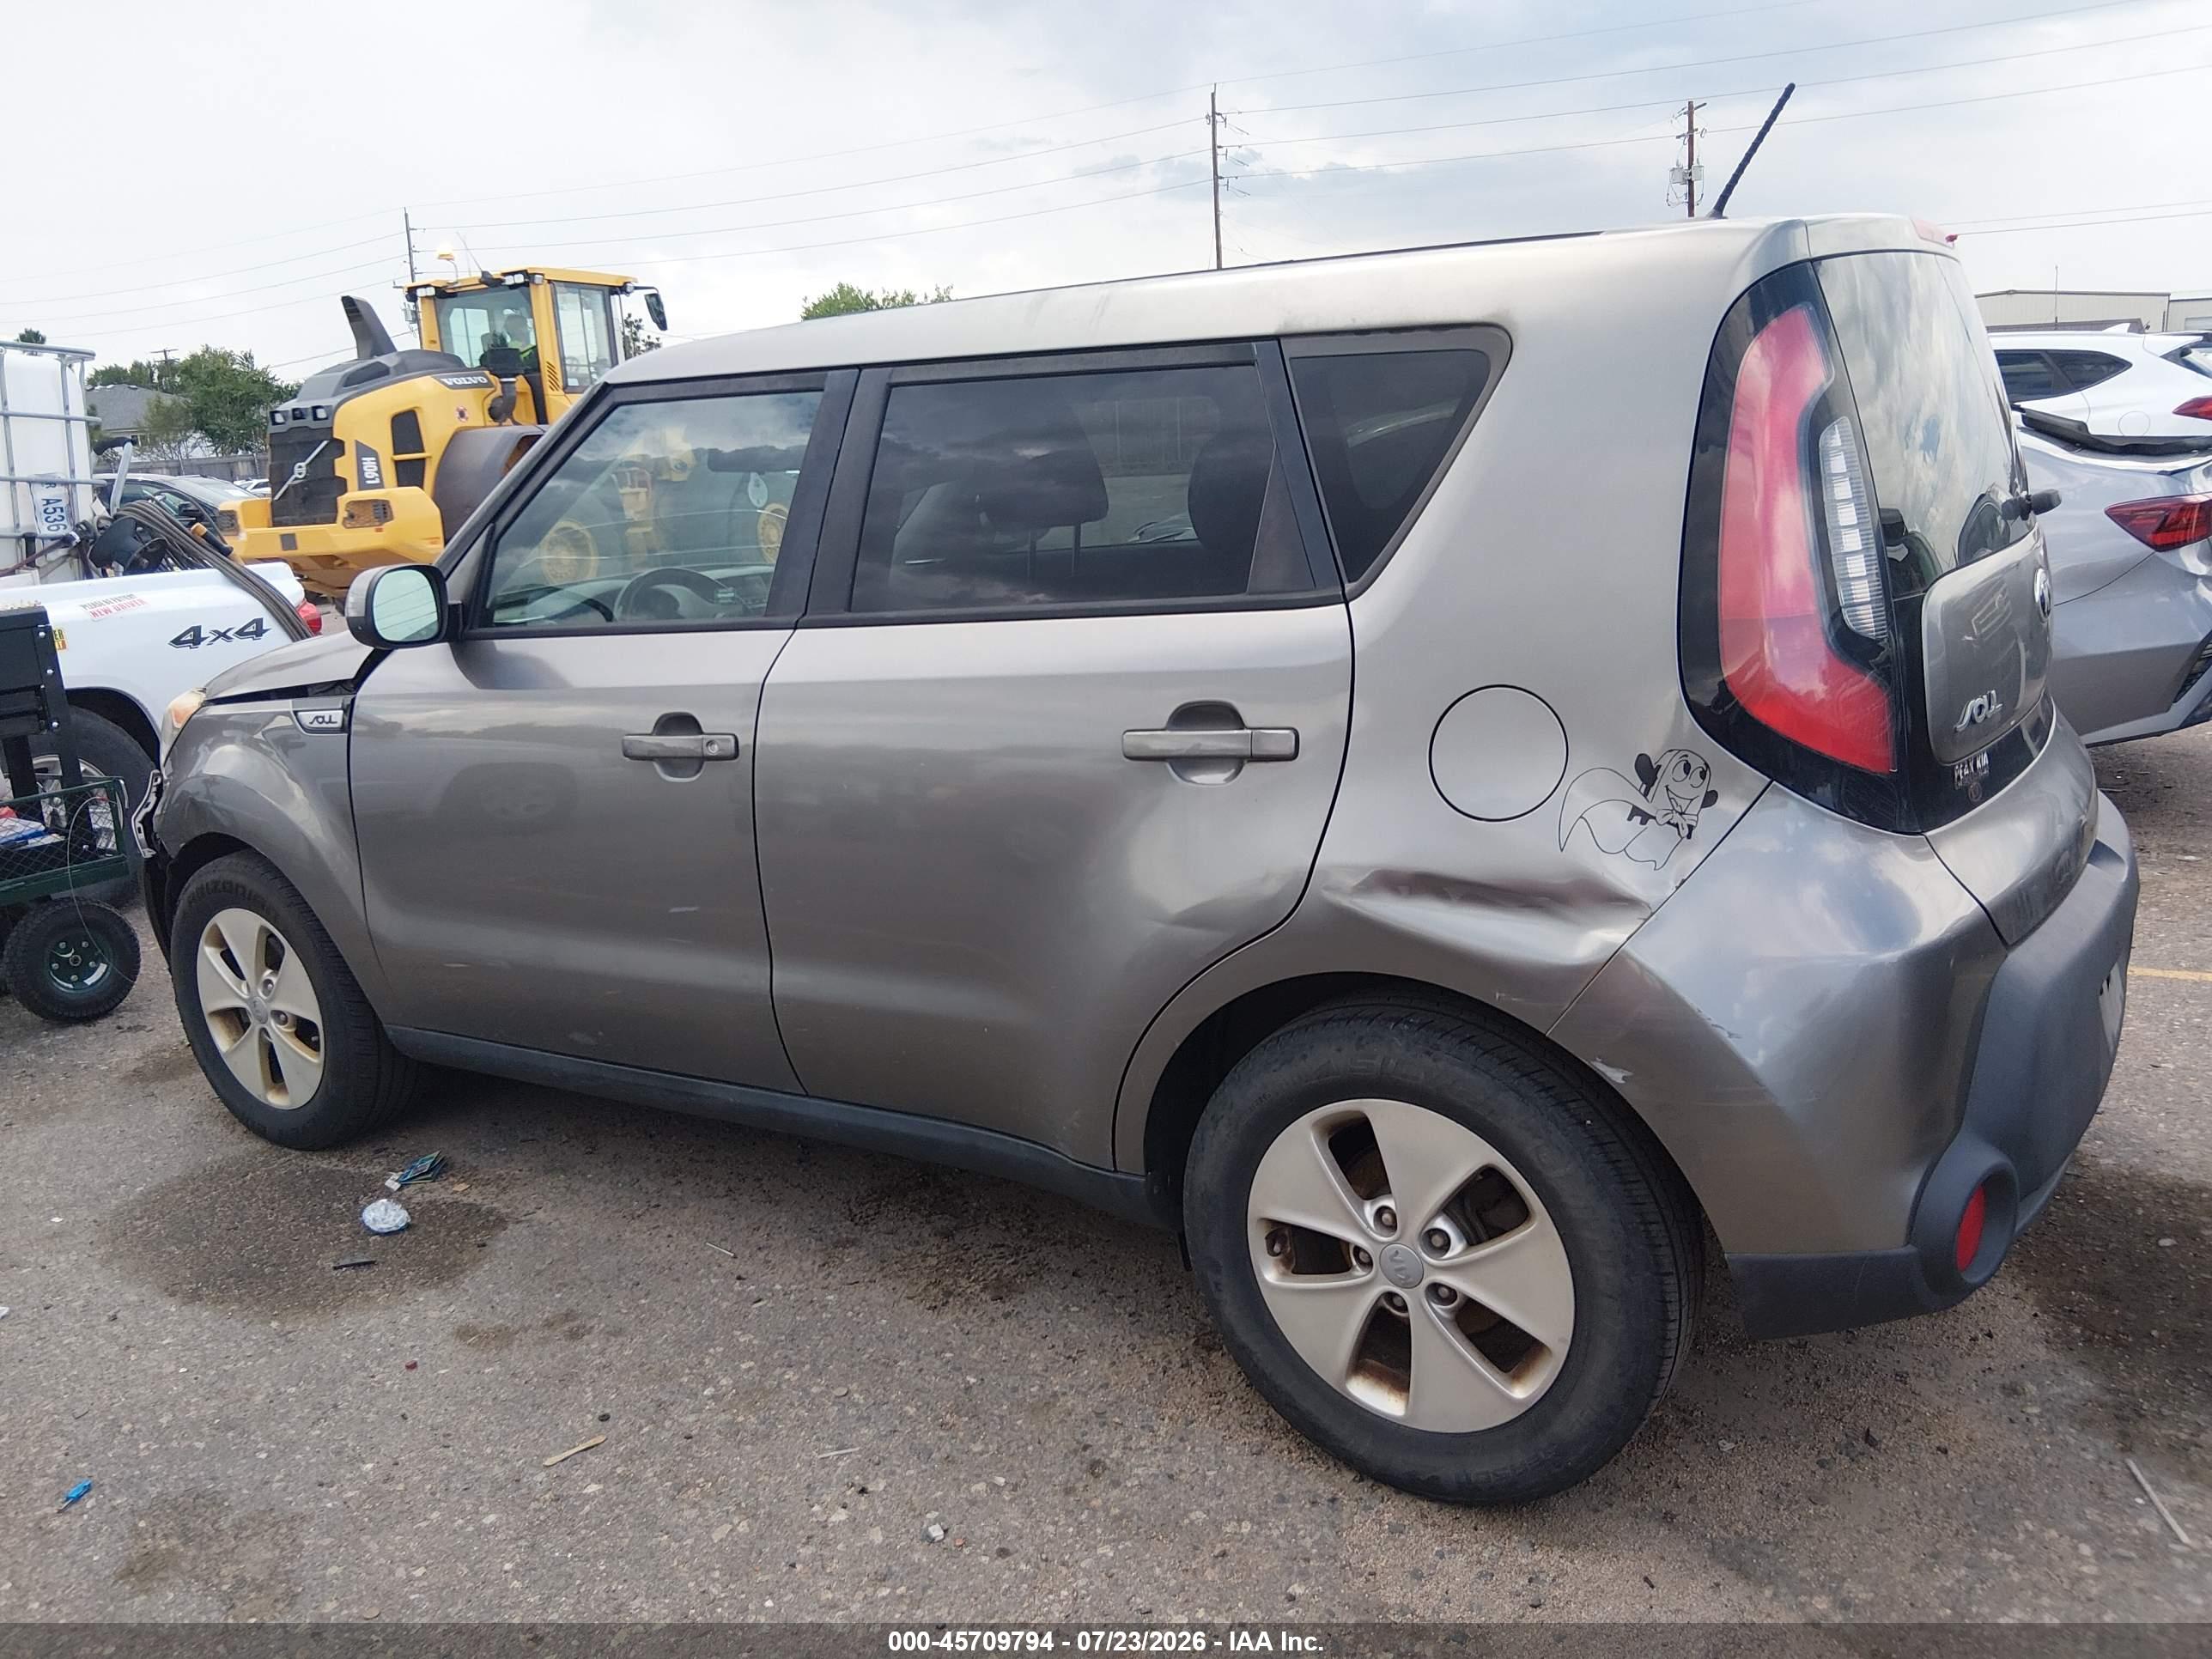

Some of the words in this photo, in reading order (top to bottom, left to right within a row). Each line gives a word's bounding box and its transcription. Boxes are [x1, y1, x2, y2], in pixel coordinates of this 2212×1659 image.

[441, 376, 488, 386] VOLVO
[40, 498, 68, 532] A536
[89, 606, 112, 618] NEW
[113, 598, 148, 612] DRIVER
[167, 617, 272, 649] 4x4
[1976, 751, 1989, 769] KIA
